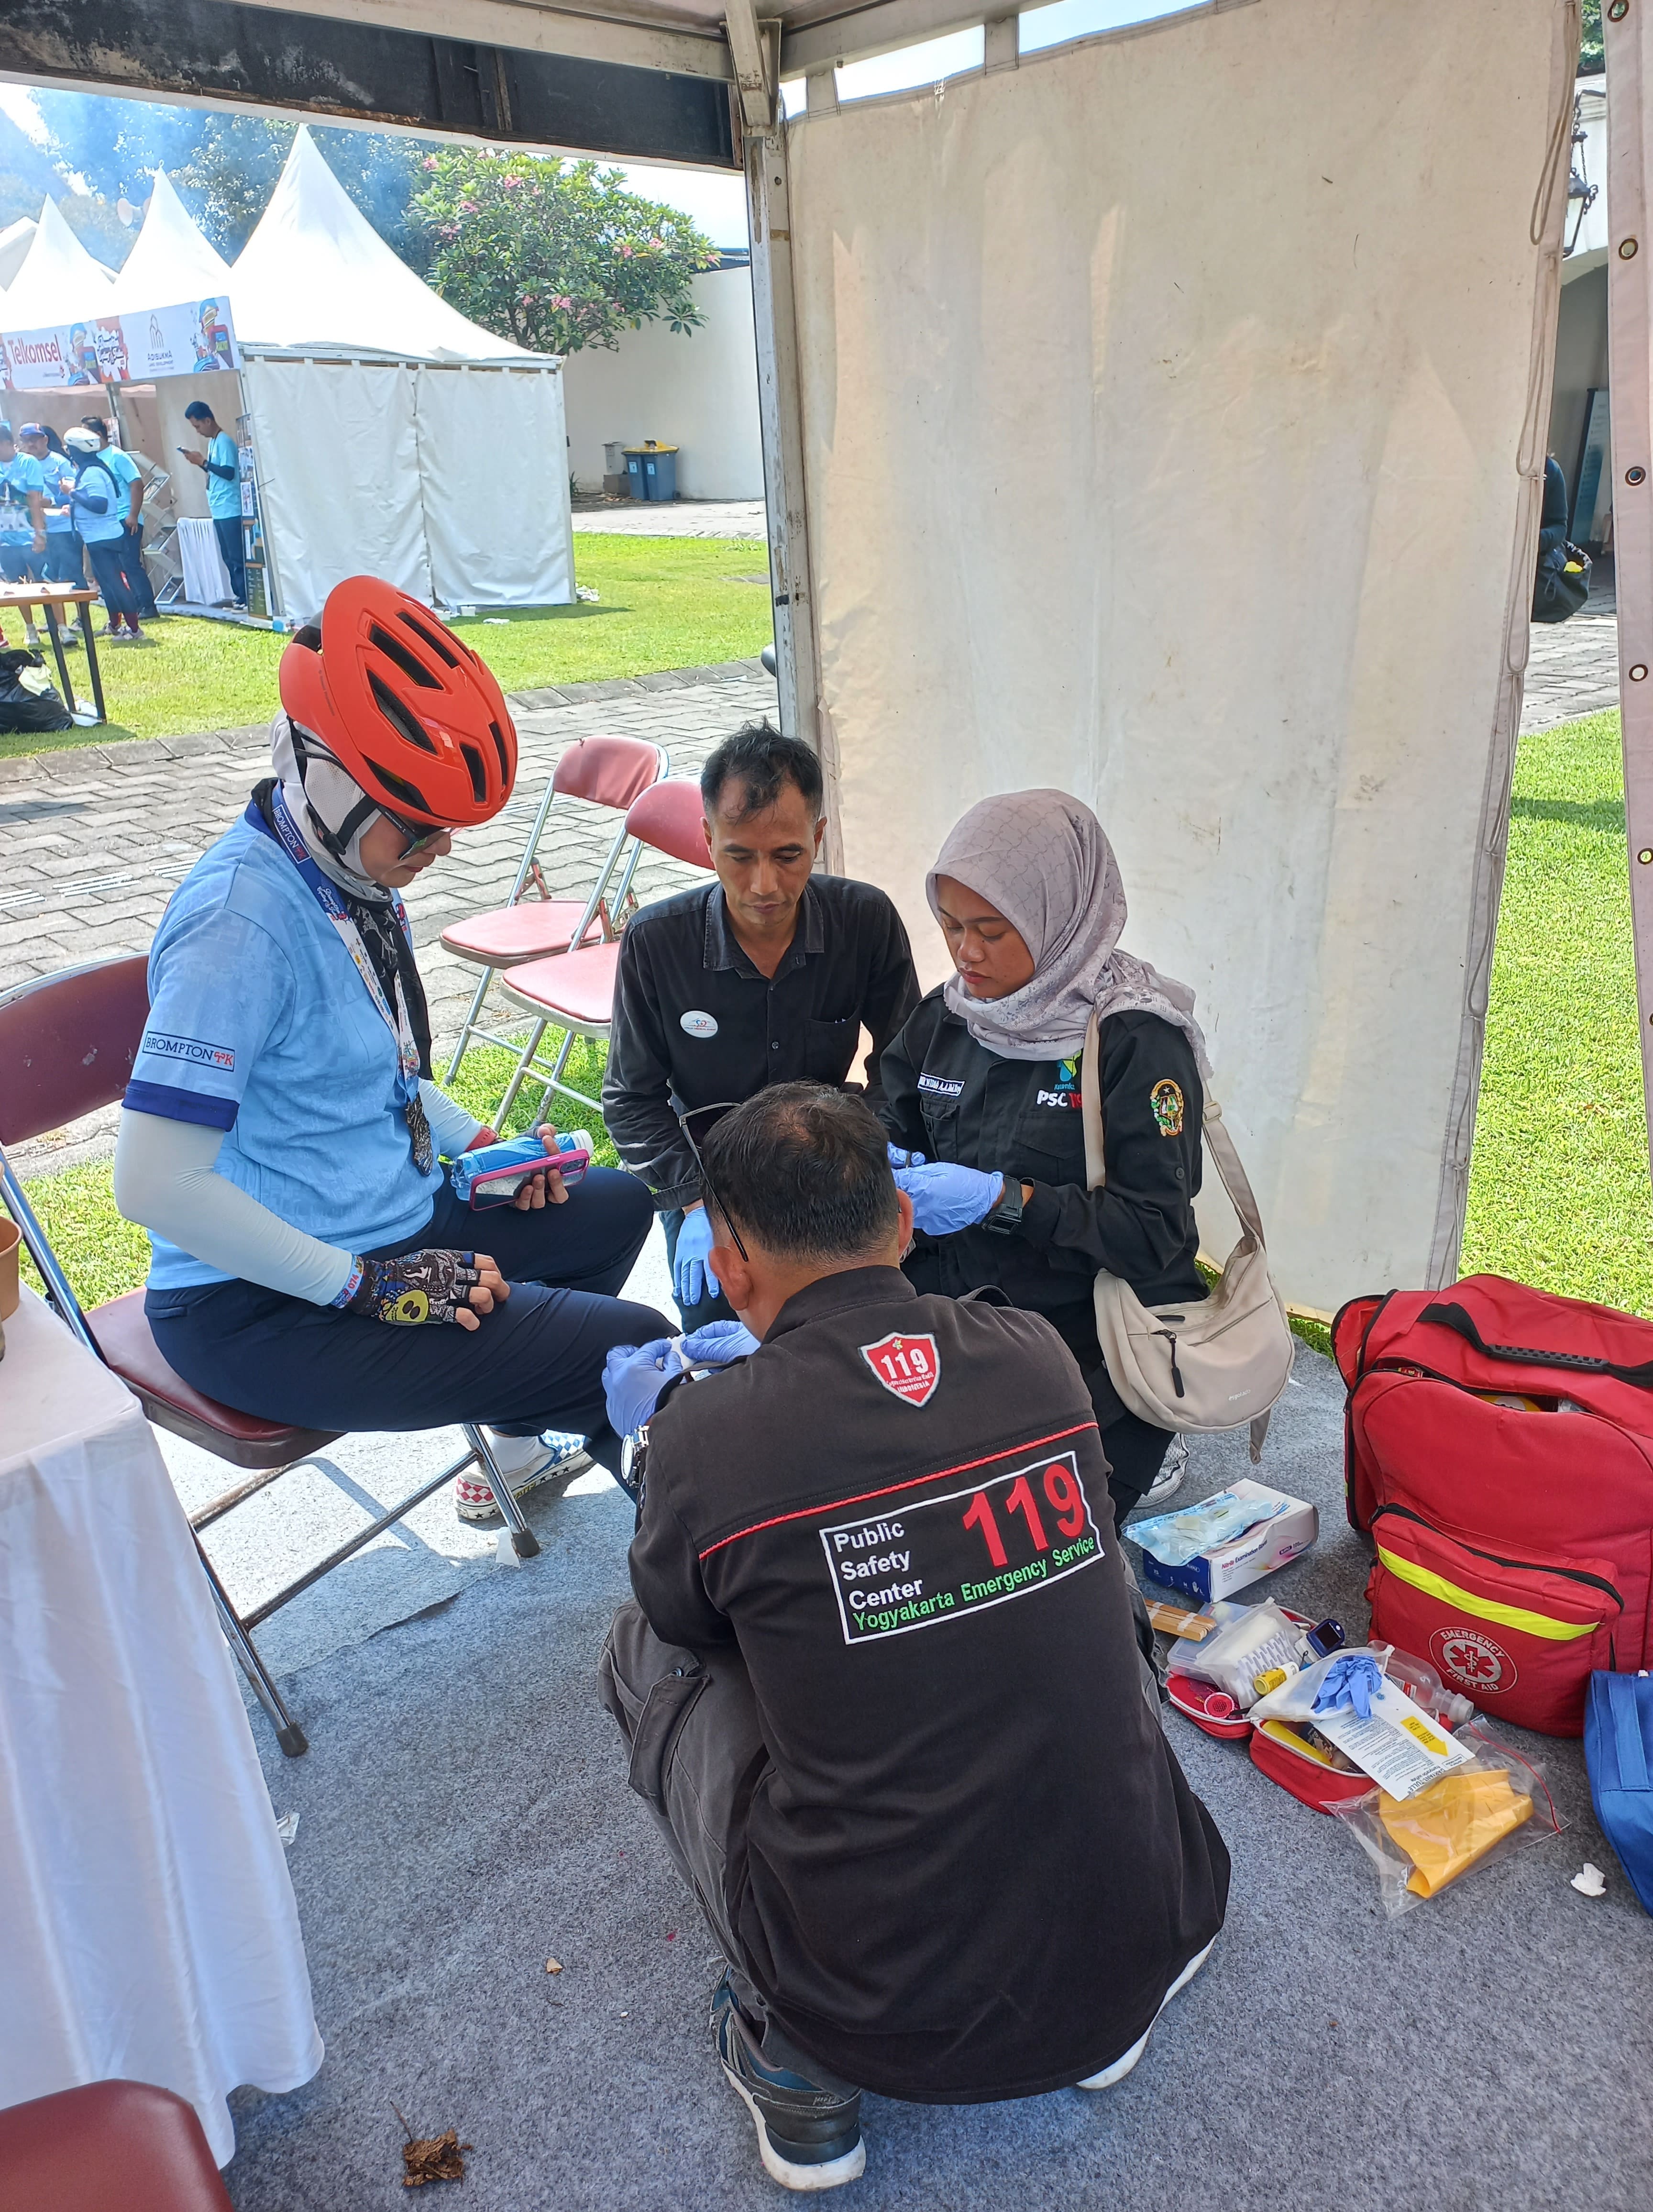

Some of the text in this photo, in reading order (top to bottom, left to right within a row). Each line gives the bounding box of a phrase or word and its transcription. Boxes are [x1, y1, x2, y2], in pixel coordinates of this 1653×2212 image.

[8, 333, 62, 364] Telkomsel
[274, 808, 299, 848] BROMPTON
[145, 1037, 214, 1061] BROMPTON
[1036, 1090, 1068, 1107] PSC
[881, 1348, 929, 1379] 119
[897, 1381, 930, 1393] INDONESIA
[962, 1464, 1085, 1568] 119
[833, 1520, 905, 1552] Public
[840, 1550, 910, 1581] Safety
[1235, 1548, 1258, 1563] Examination
[849, 1578, 923, 1610] Center
[853, 1536, 1095, 1631] Yogyakarta Emergency Service
[1440, 1629, 1505, 1658] EMERGENCY
[1446, 1668, 1499, 1691] FIRST AID
